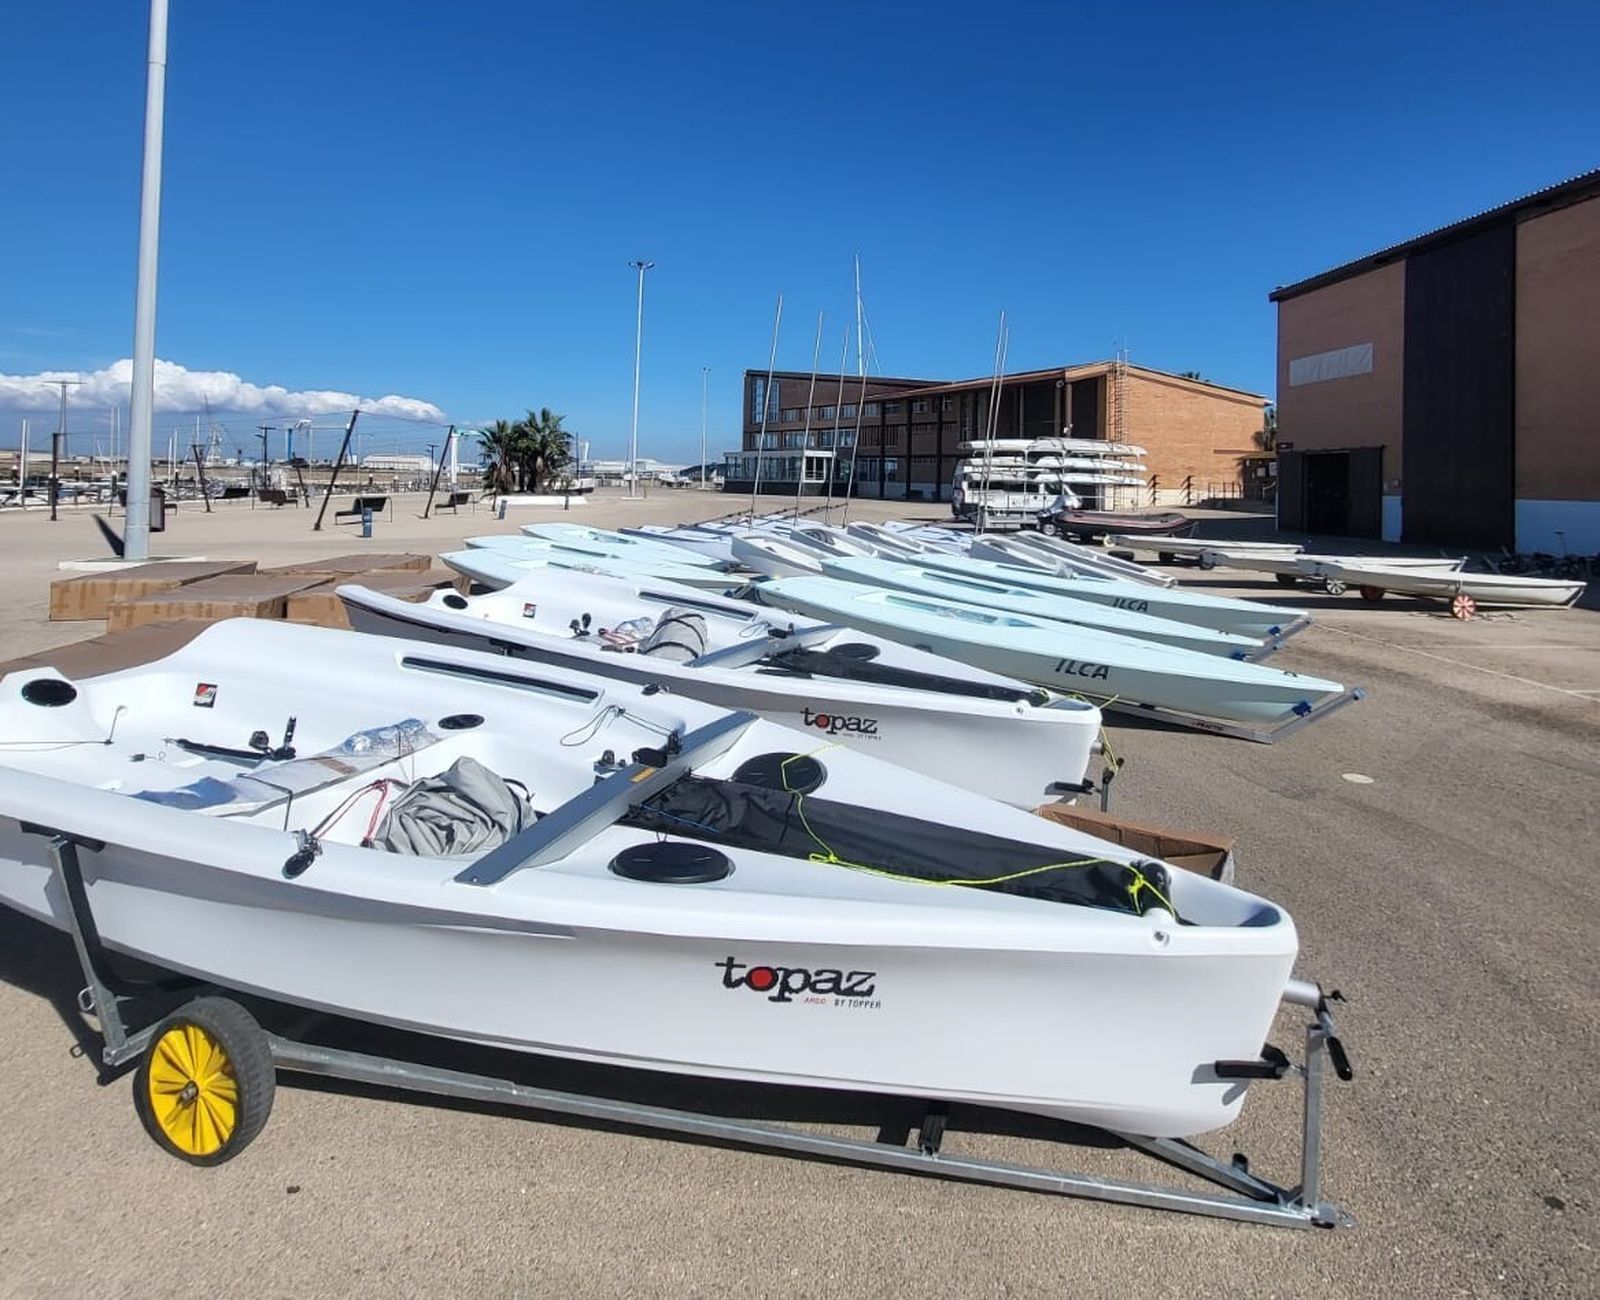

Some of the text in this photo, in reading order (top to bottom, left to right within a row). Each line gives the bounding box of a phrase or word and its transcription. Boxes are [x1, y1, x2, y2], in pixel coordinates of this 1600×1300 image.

[1113, 598, 1149, 613] ILCA
[1055, 658, 1110, 680] ILCA
[800, 707, 878, 734] topaz
[715, 956, 876, 1002] topaz
[834, 998, 845, 1007] BY
[848, 999, 881, 1009] TOPPER
